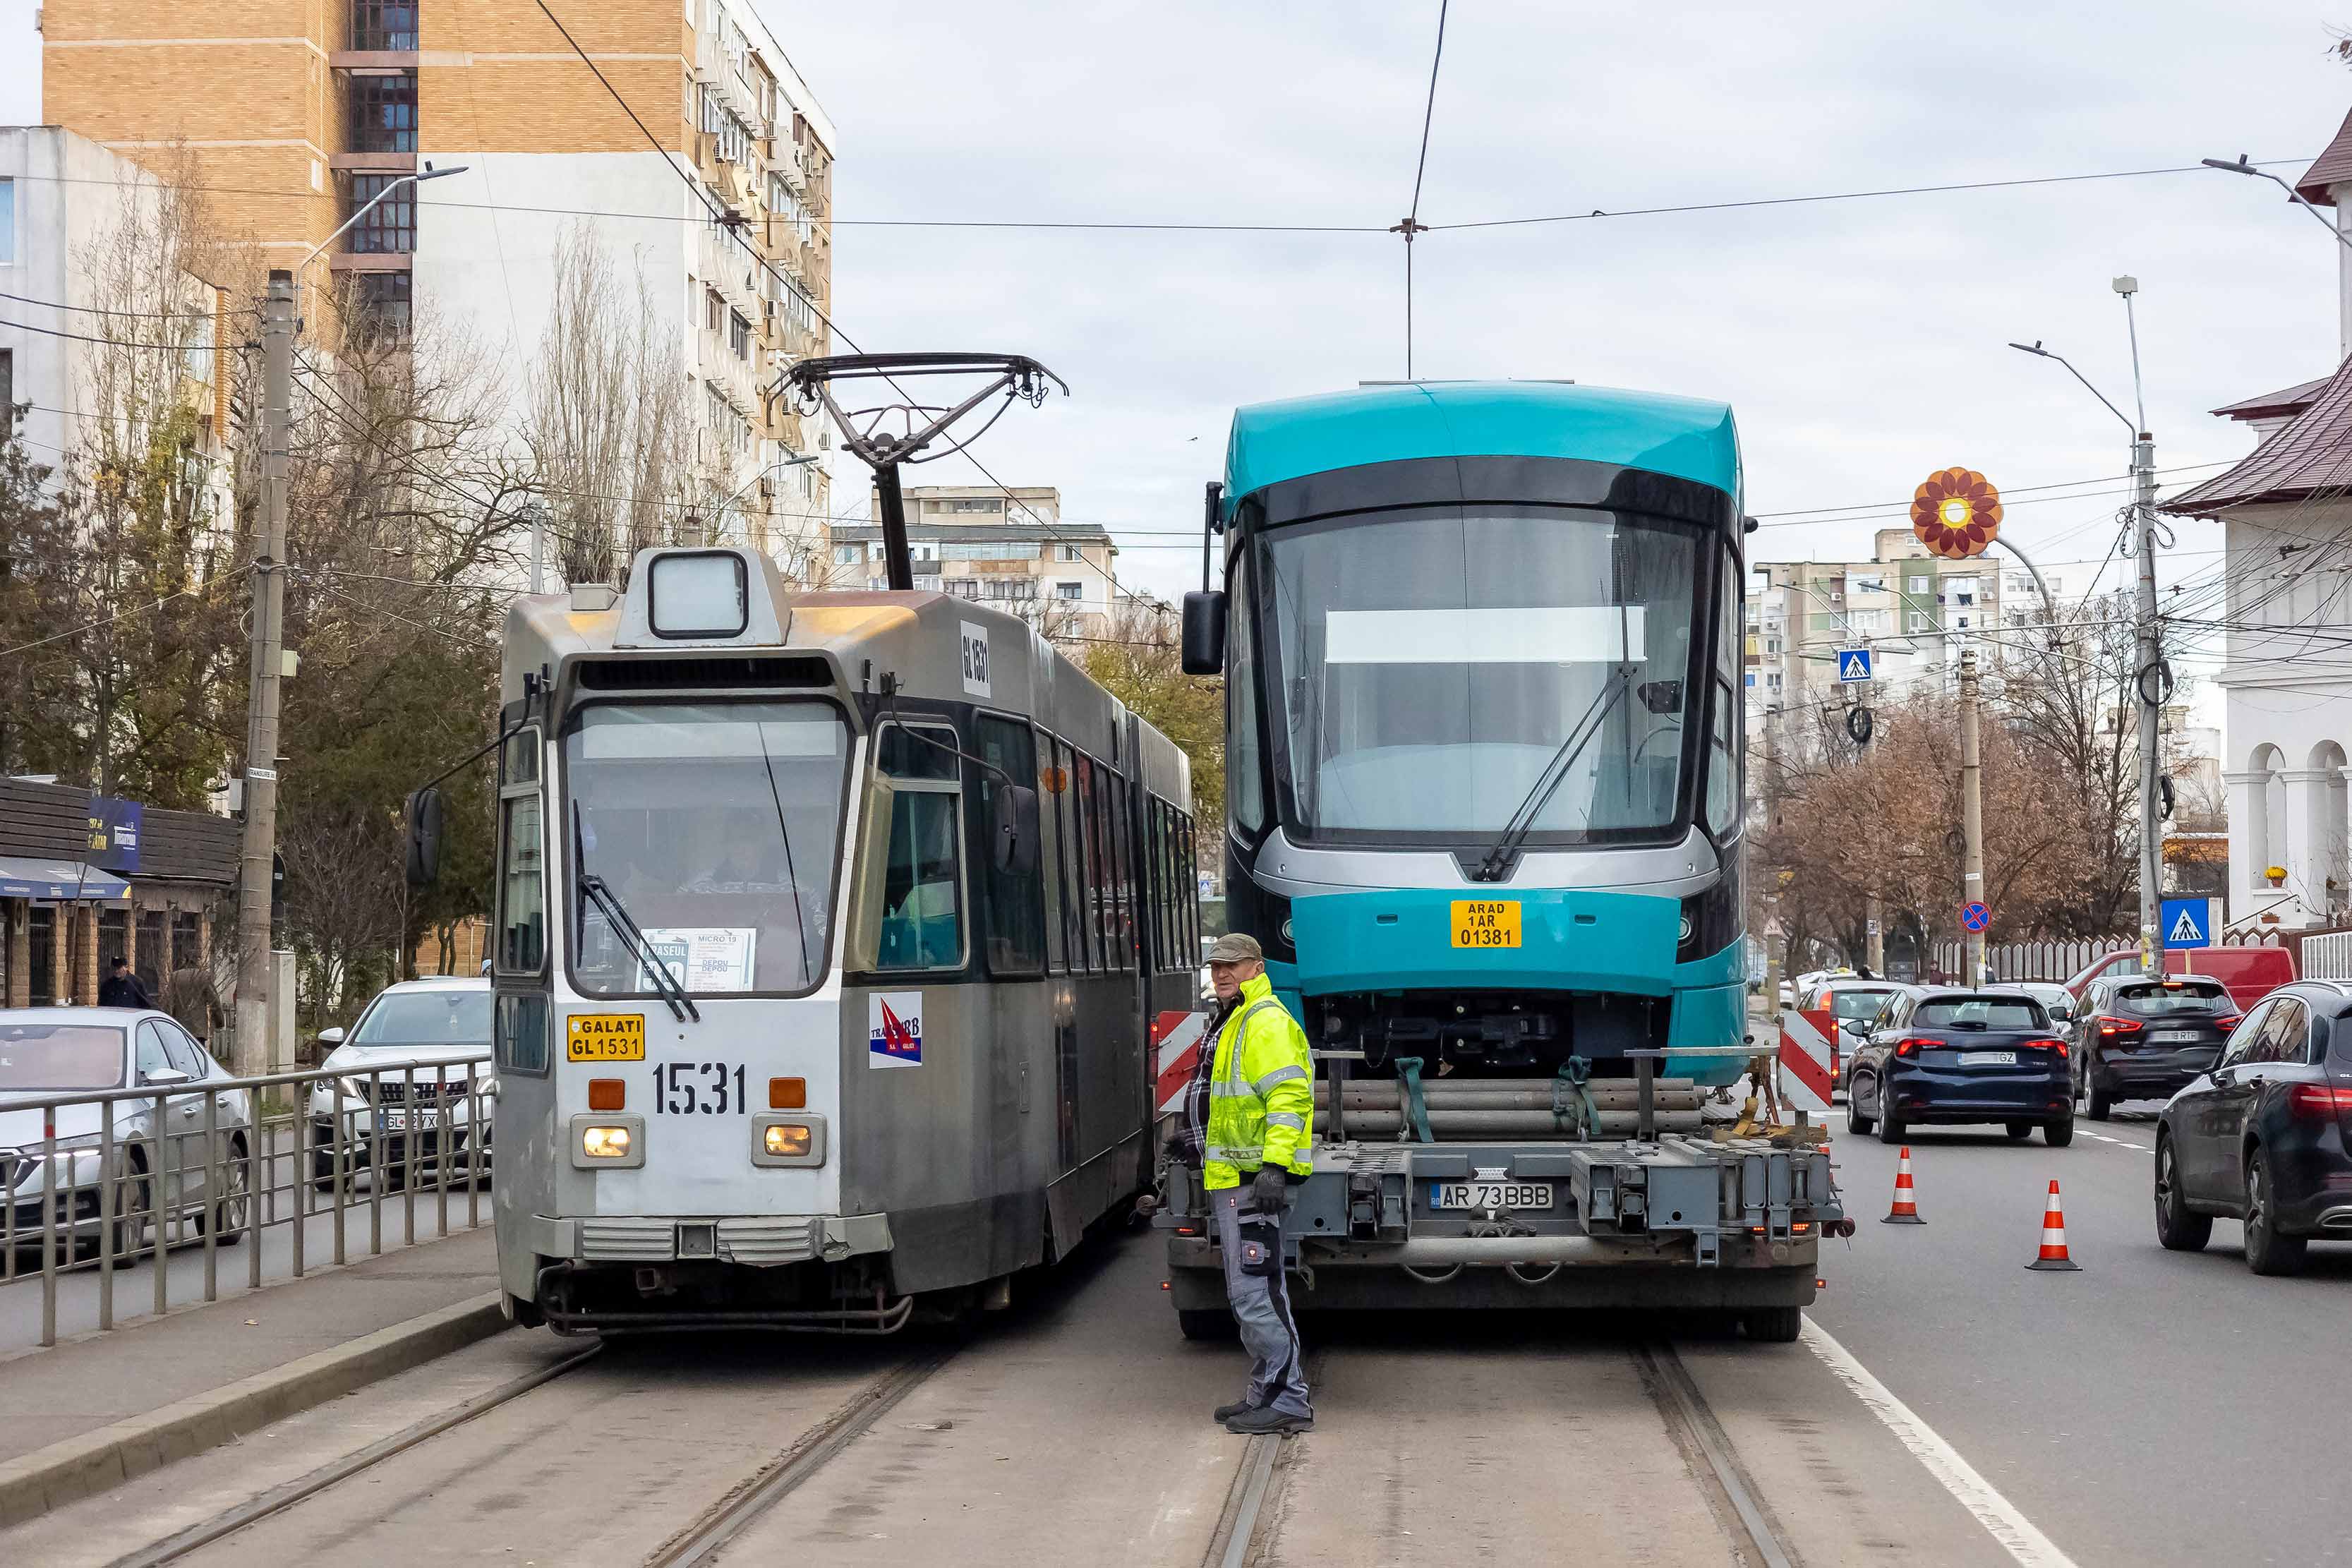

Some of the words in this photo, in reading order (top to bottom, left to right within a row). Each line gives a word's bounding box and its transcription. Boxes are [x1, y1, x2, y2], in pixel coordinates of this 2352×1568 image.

[963, 635, 972, 679] GL
[972, 638, 989, 683] 1531
[1469, 904, 1504, 913] ARAD
[1461, 929, 1510, 945] 01381
[581, 1020, 641, 1033] GALATI
[652, 1063, 745, 1114] 1531
[1443, 1186, 1469, 1206] AR
[1478, 1186, 1502, 1205] 73
[1505, 1186, 1550, 1206] BBB
